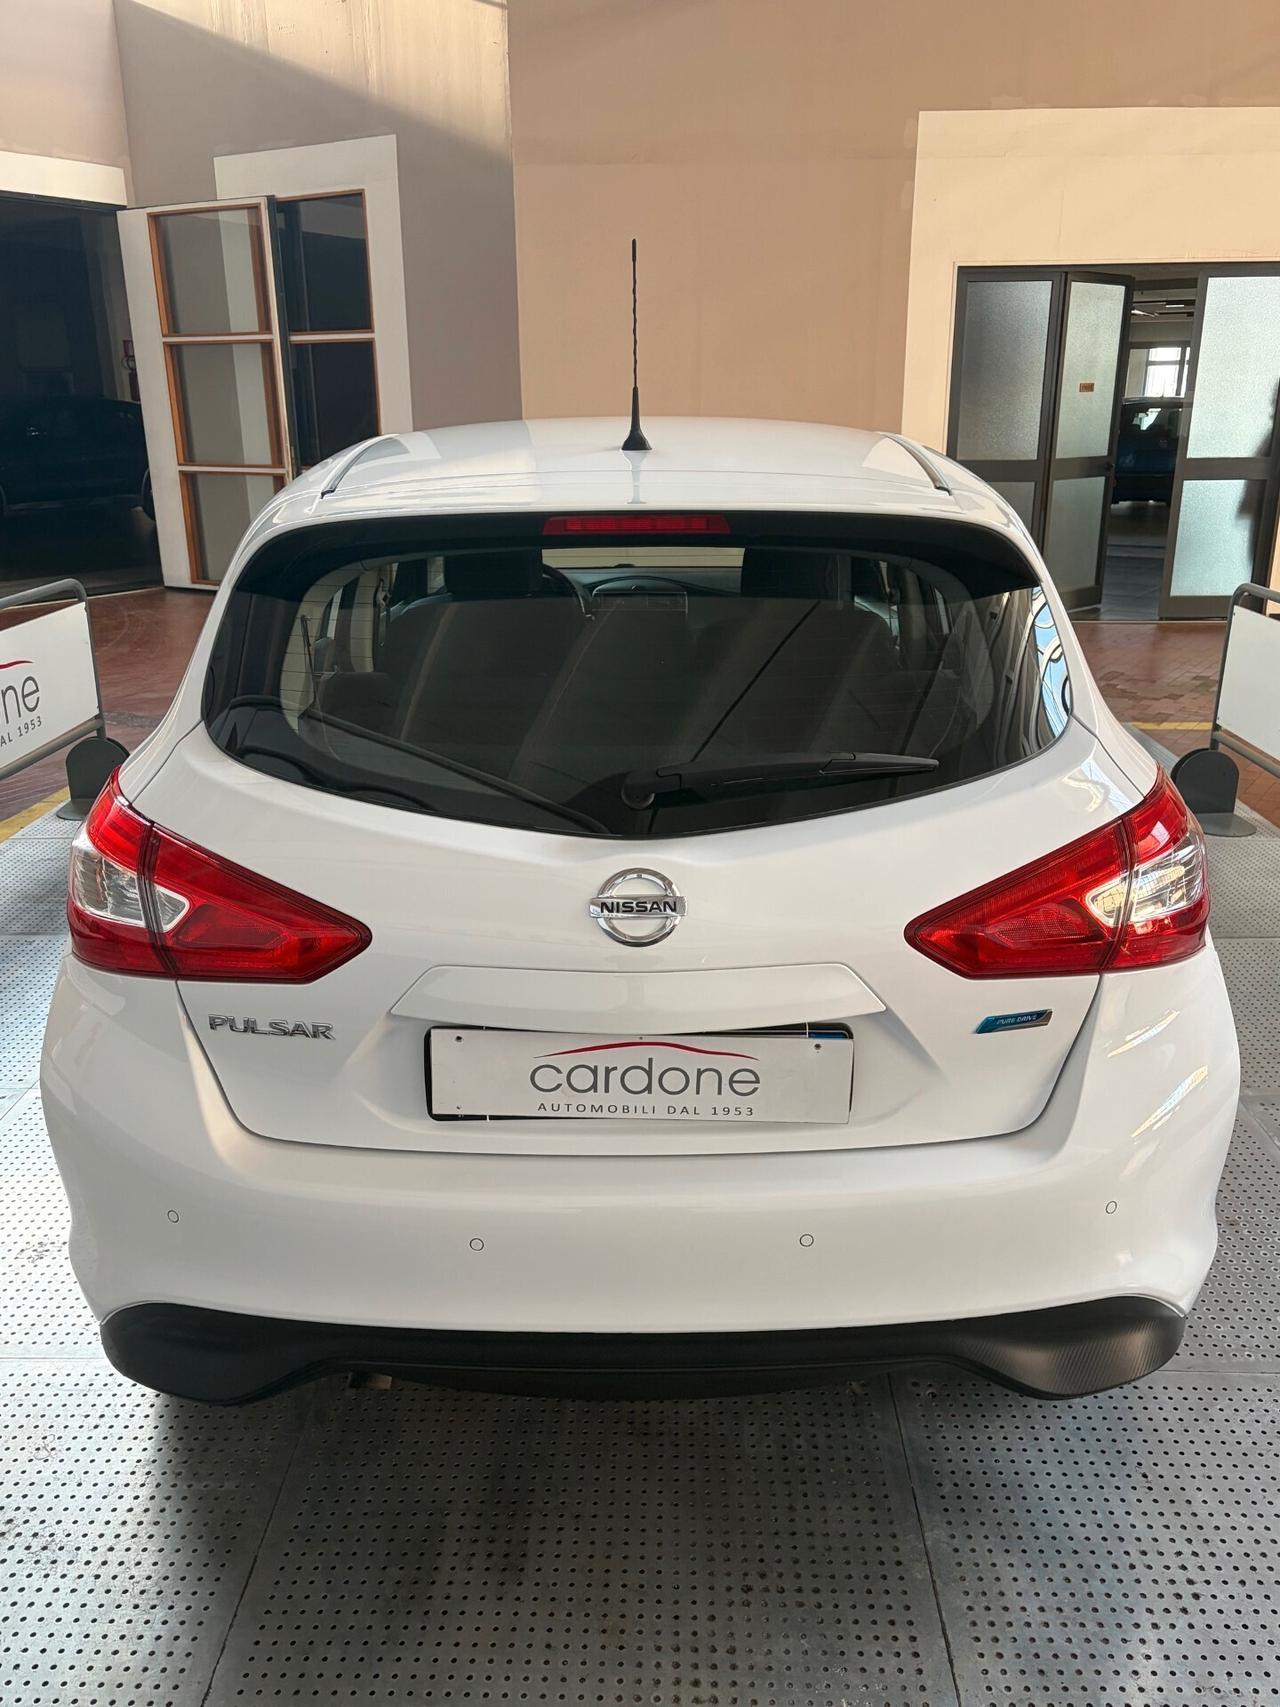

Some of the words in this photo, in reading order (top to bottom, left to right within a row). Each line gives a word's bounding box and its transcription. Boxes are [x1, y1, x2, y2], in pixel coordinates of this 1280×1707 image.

[17, 716, 42, 737] 1953
[600, 901, 677, 914] NISSAN
[208, 1014, 336, 1040] PULSAR
[530, 1057, 761, 1097] cardone
[537, 1102, 656, 1114] AUTOMOBILI
[667, 1105, 700, 1115] DAL
[711, 1106, 754, 1116] 1953
